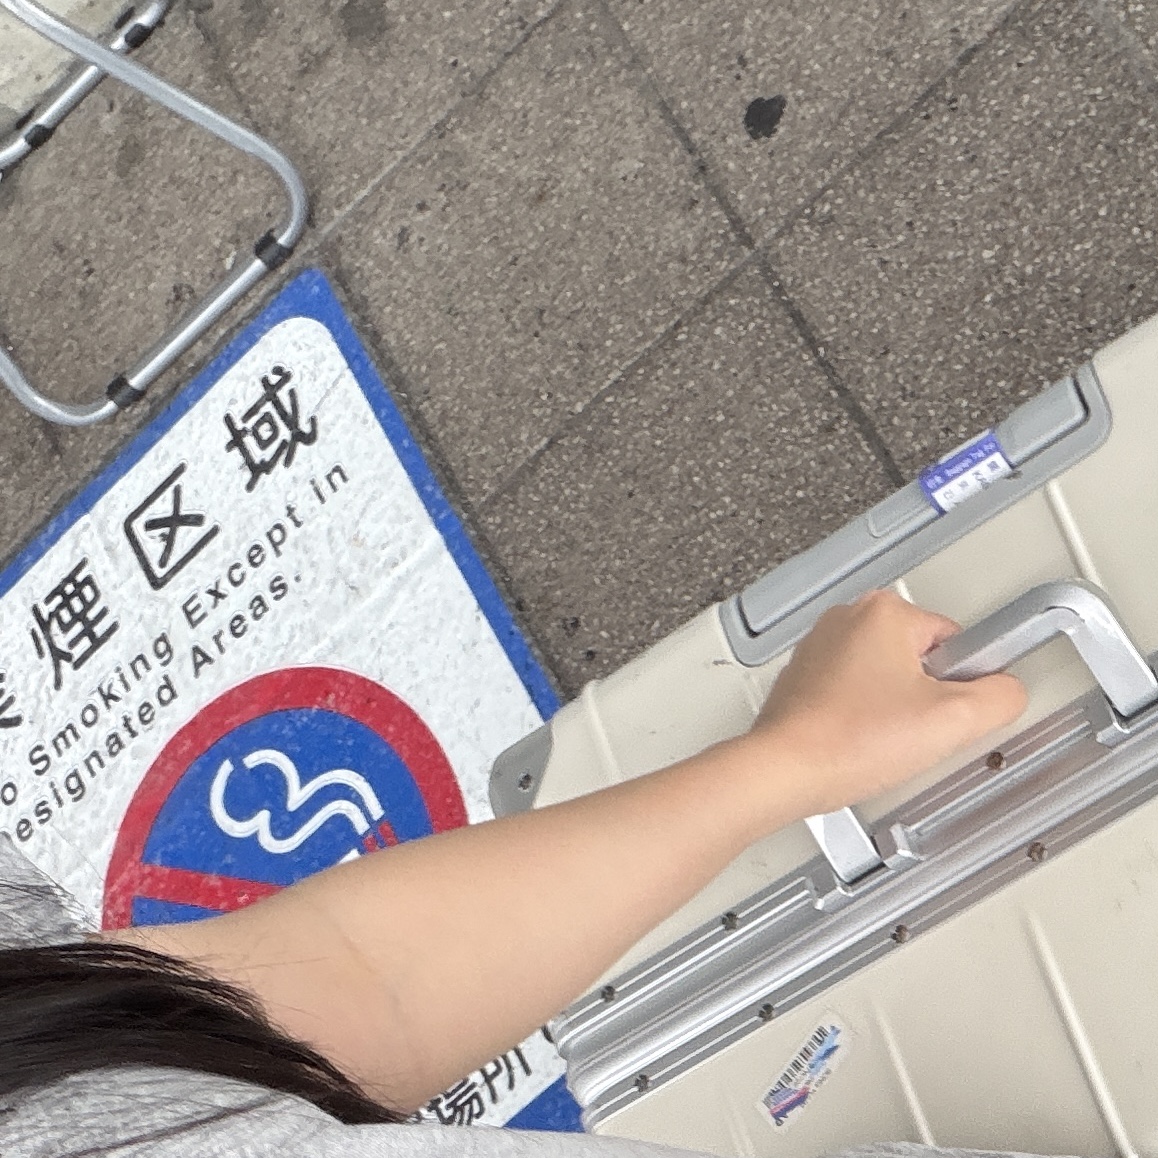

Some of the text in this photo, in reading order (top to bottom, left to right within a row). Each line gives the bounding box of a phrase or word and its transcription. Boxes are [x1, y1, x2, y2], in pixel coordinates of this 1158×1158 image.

[0, 573, 302, 845] esignated Areas.
[28, 631, 174, 777] Smoking
[182, 503, 304, 630] Except
[309, 464, 349, 504] in
